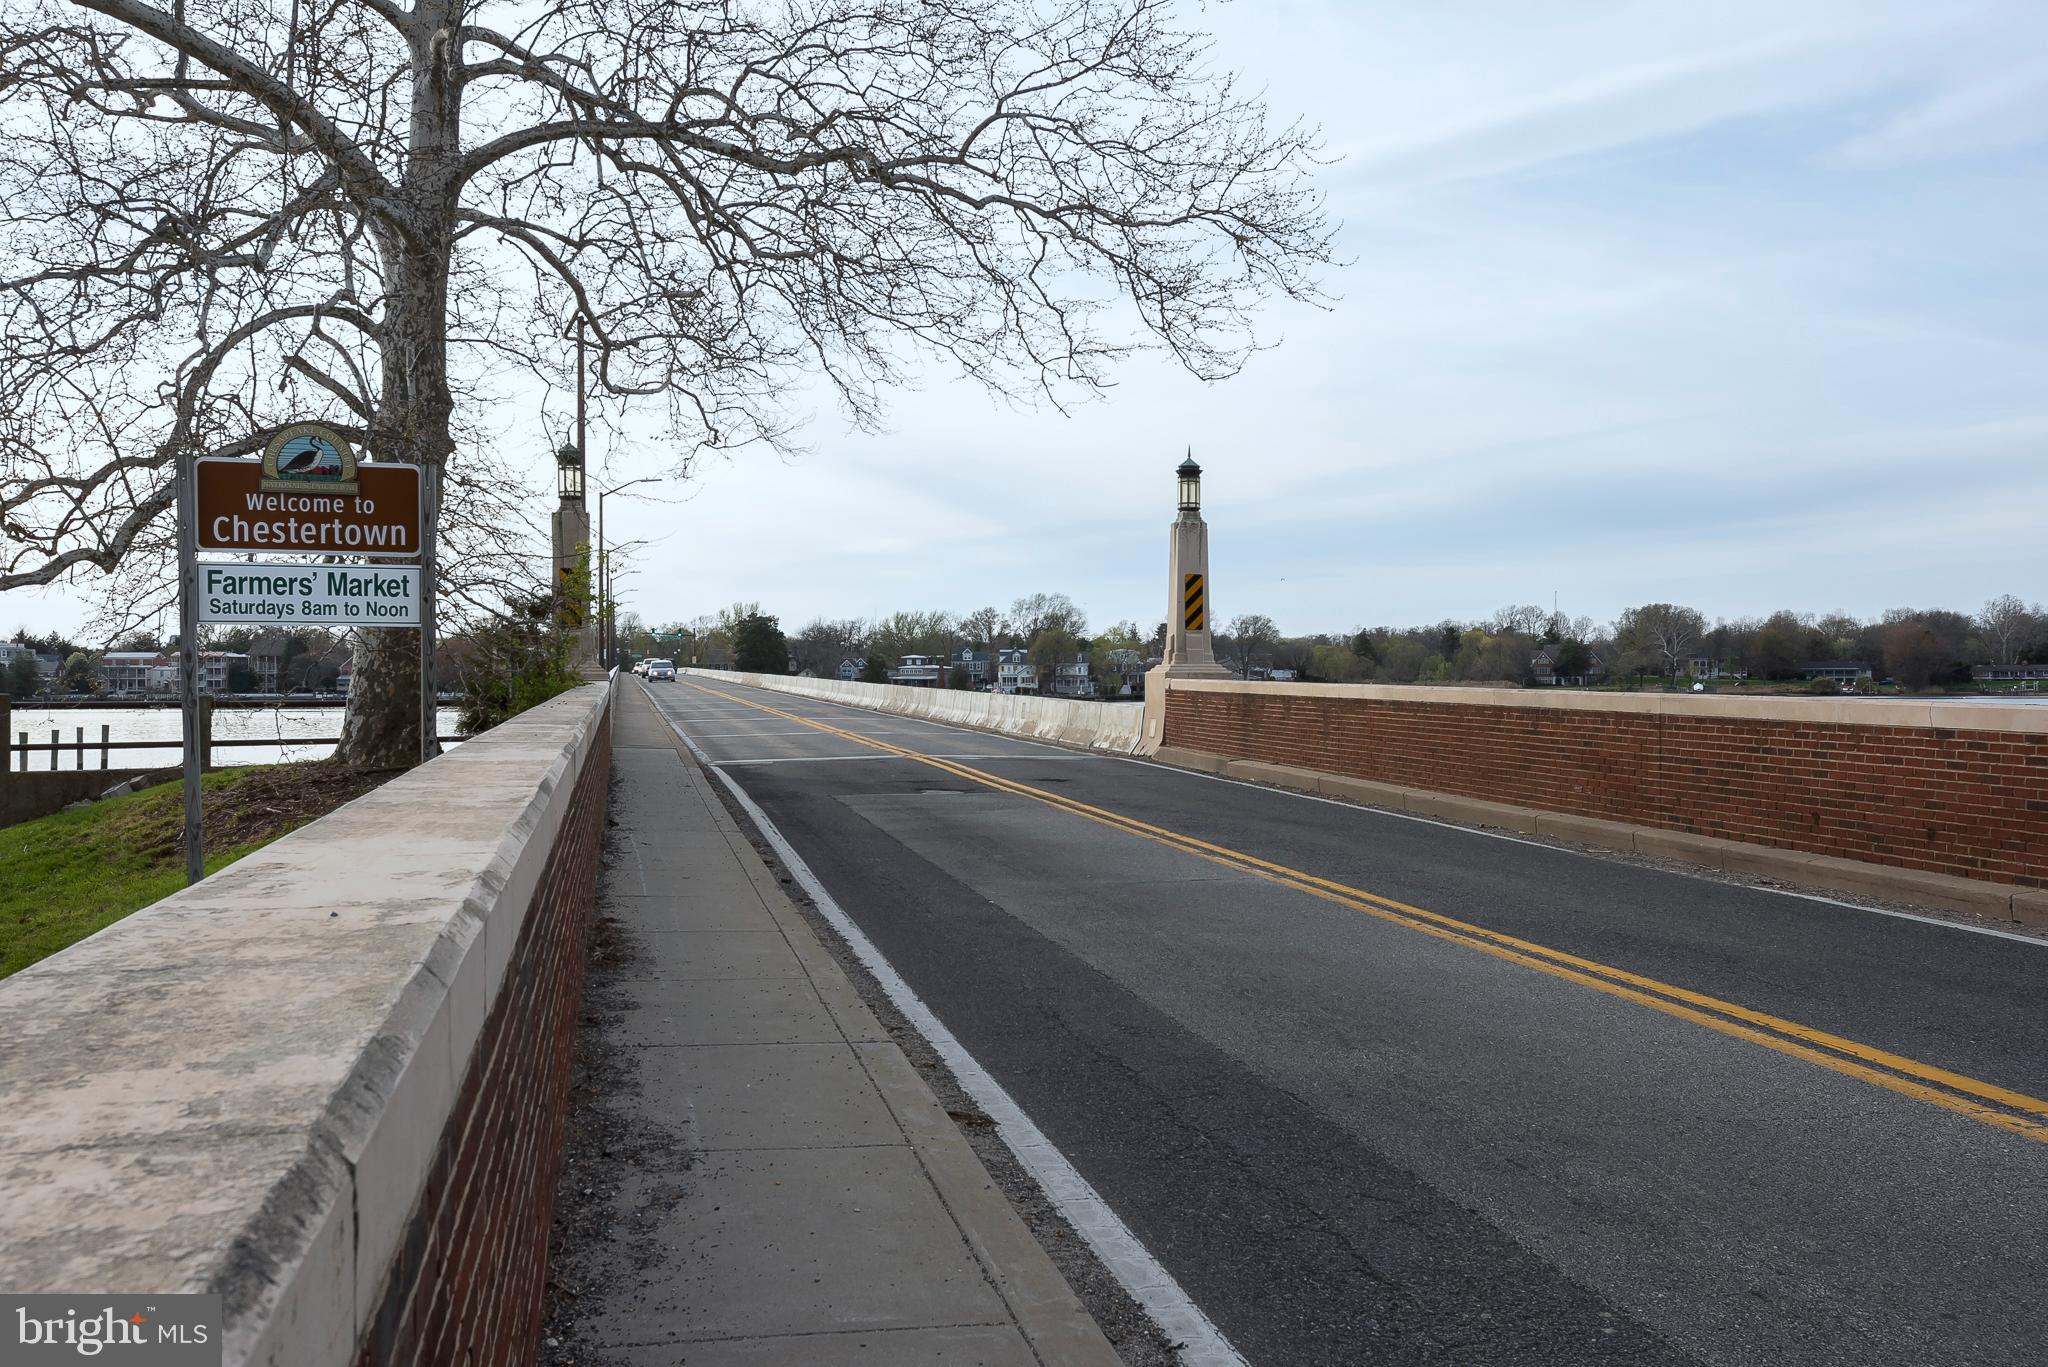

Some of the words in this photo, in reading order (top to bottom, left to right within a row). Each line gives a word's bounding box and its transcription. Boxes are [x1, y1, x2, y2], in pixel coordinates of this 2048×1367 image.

[267, 426, 314, 466] CHESAPEAKE
[246, 493, 345, 513] Welcome
[354, 496, 375, 514] to
[212, 514, 407, 546] Chestertown
[207, 569, 317, 596] Farmers’
[327, 571, 410, 598] Market
[209, 597, 295, 619] Saturdays
[301, 600, 338, 616] 8am
[344, 601, 360, 617] to
[366, 601, 409, 617] Noon
